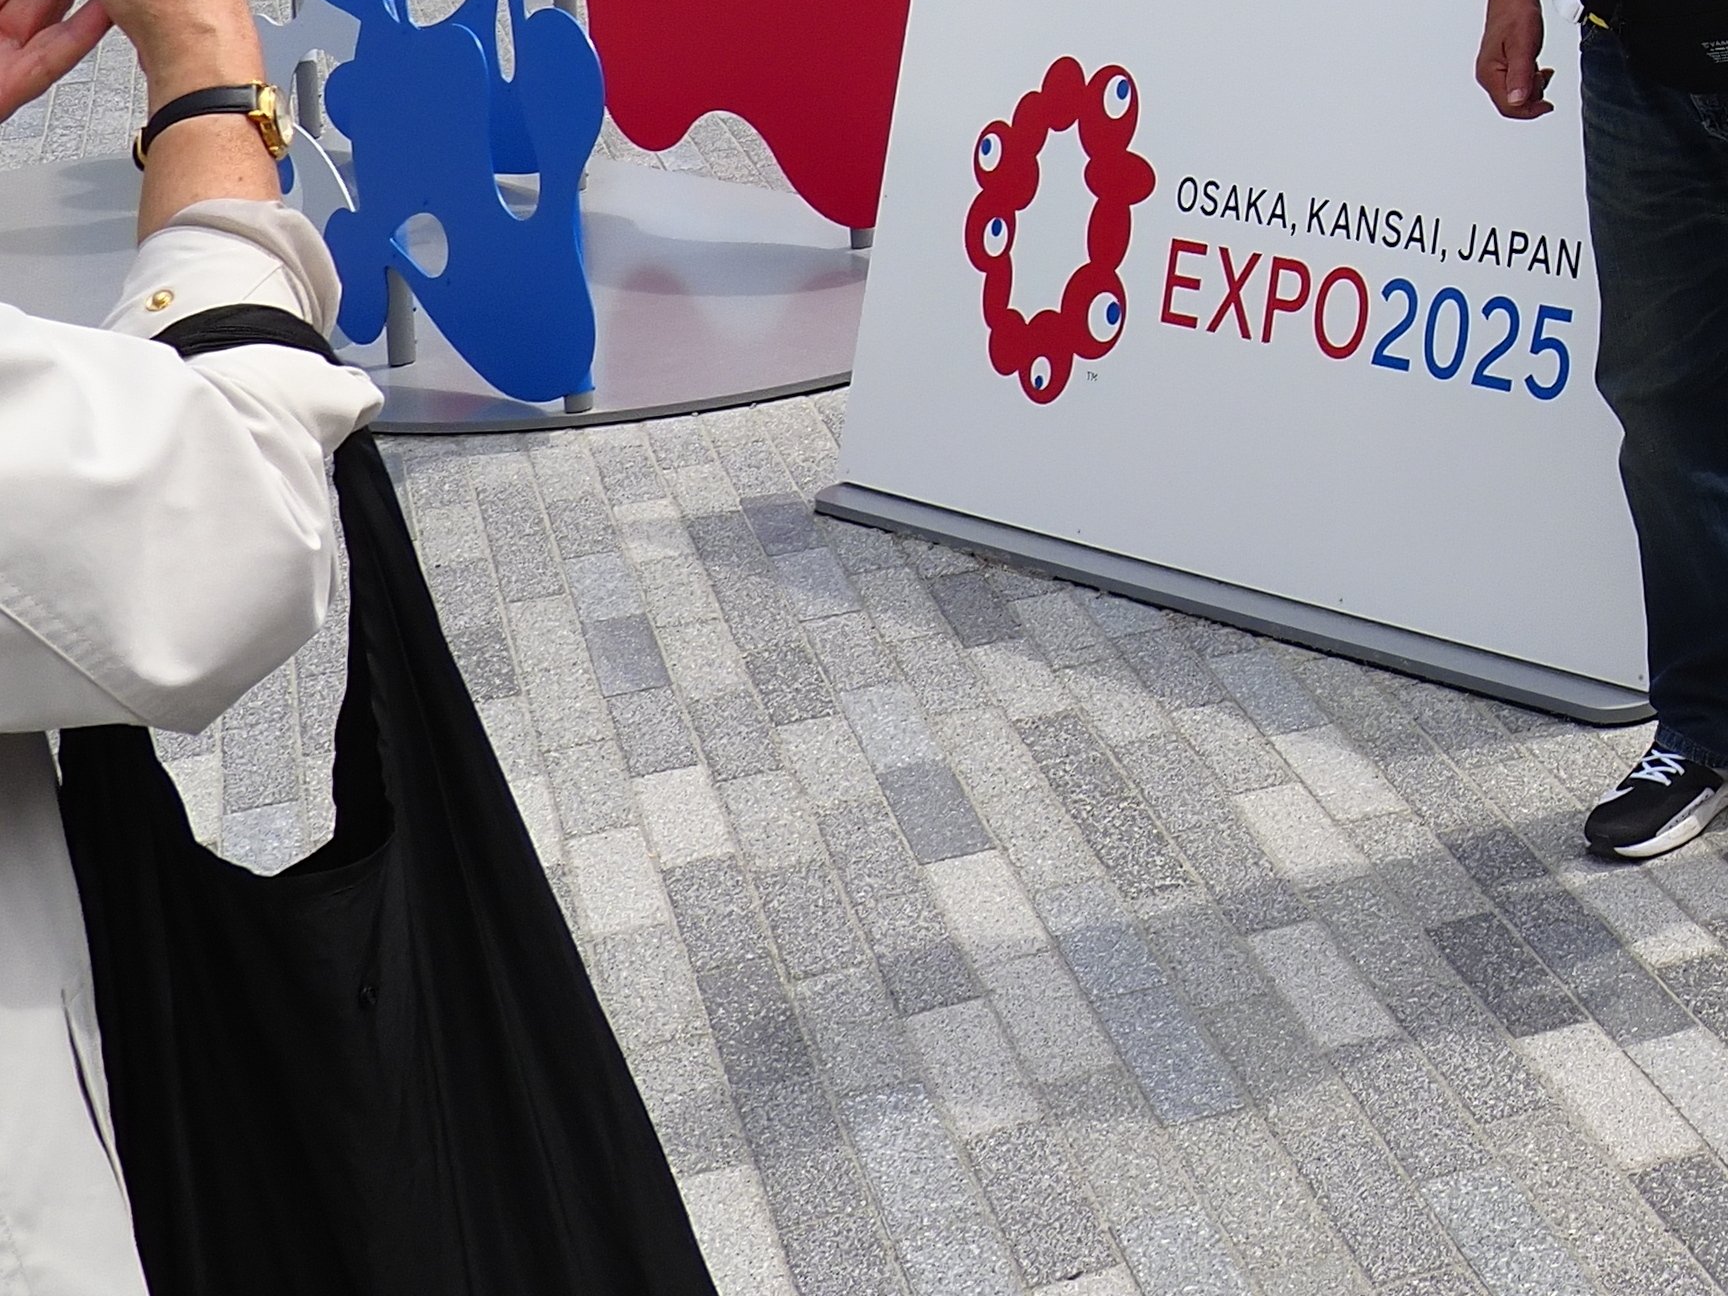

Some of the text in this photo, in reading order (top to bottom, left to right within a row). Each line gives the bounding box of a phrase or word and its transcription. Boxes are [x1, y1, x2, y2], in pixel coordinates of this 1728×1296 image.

[1176, 176, 1583, 279] OSAKA, KANSAI, JAPAN
[1159, 238, 1574, 401] EXPO2025
